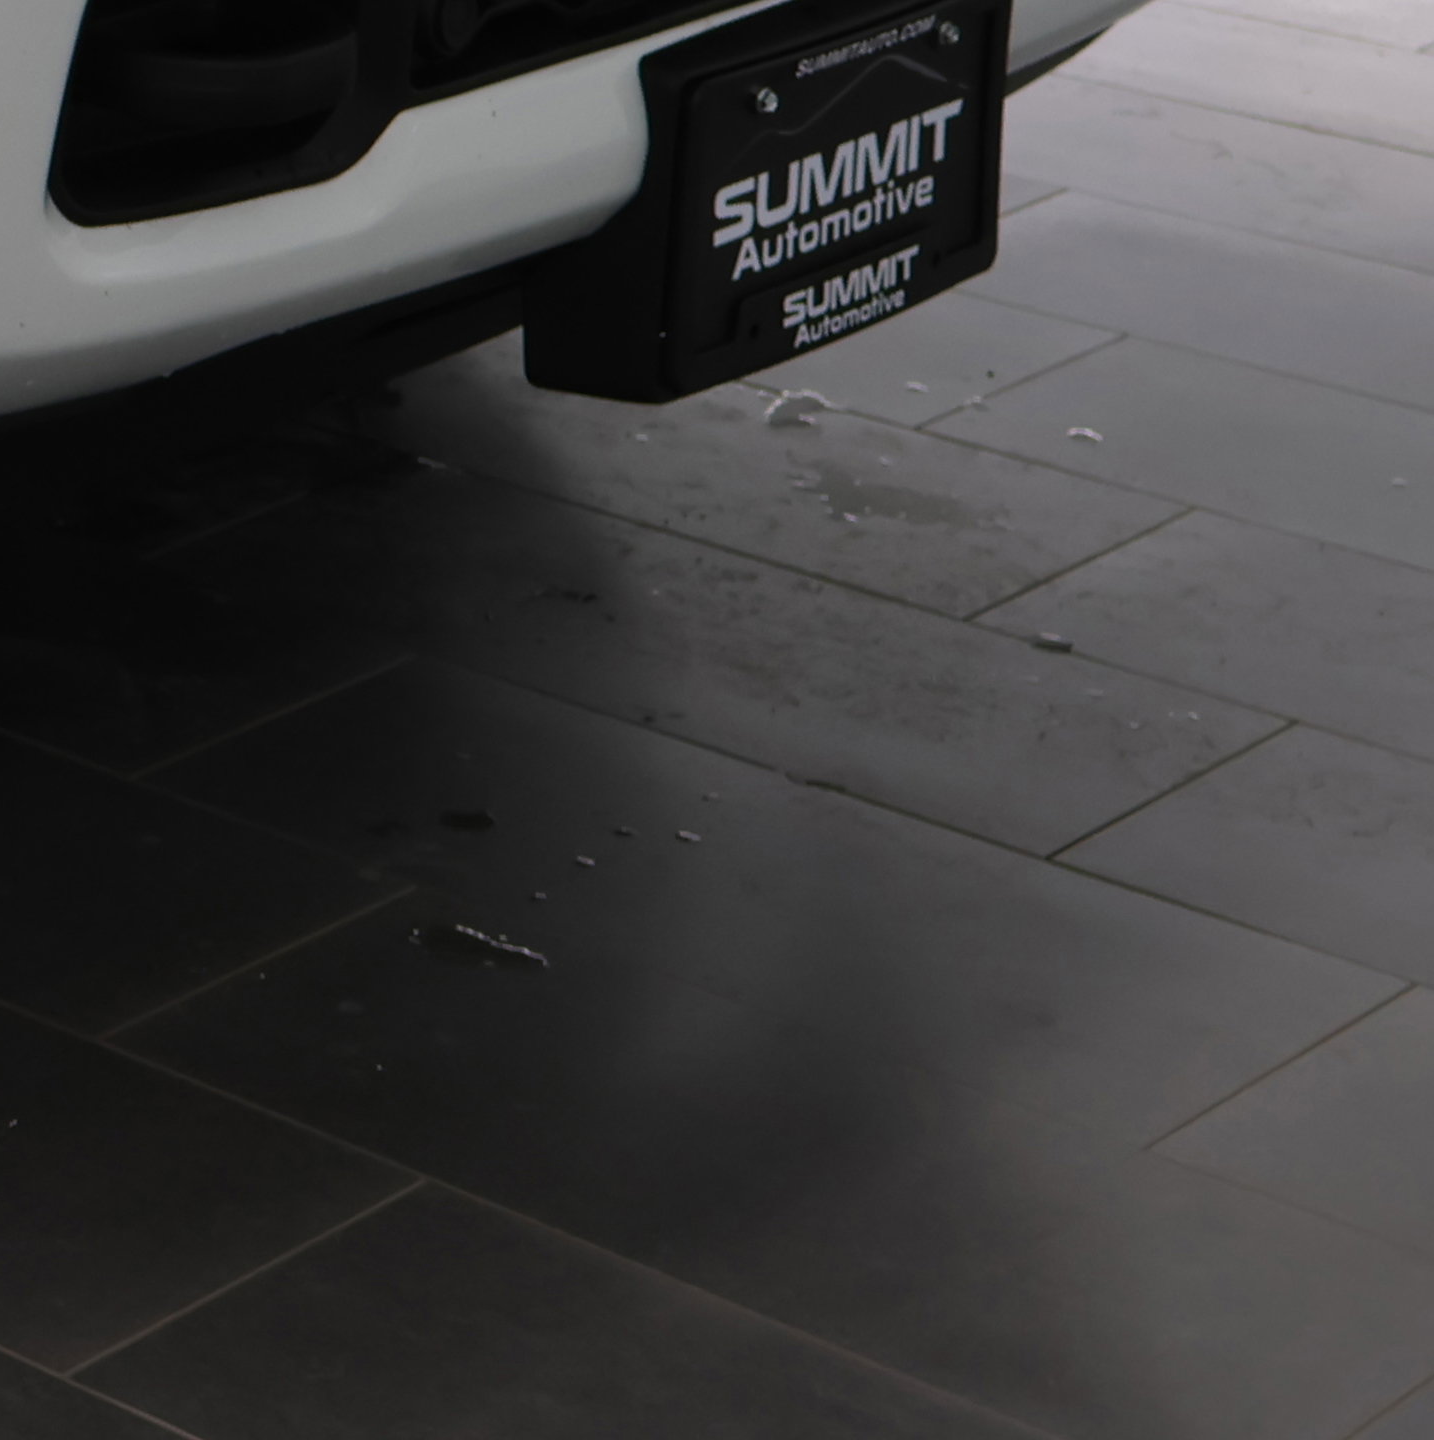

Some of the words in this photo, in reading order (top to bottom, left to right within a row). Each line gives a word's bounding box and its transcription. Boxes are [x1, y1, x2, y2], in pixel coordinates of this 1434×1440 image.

[712, 97, 965, 248] SUMMIT
[730, 174, 935, 282] Automotive
[782, 243, 921, 330] SUMMIT
[793, 288, 907, 349] Automotive
